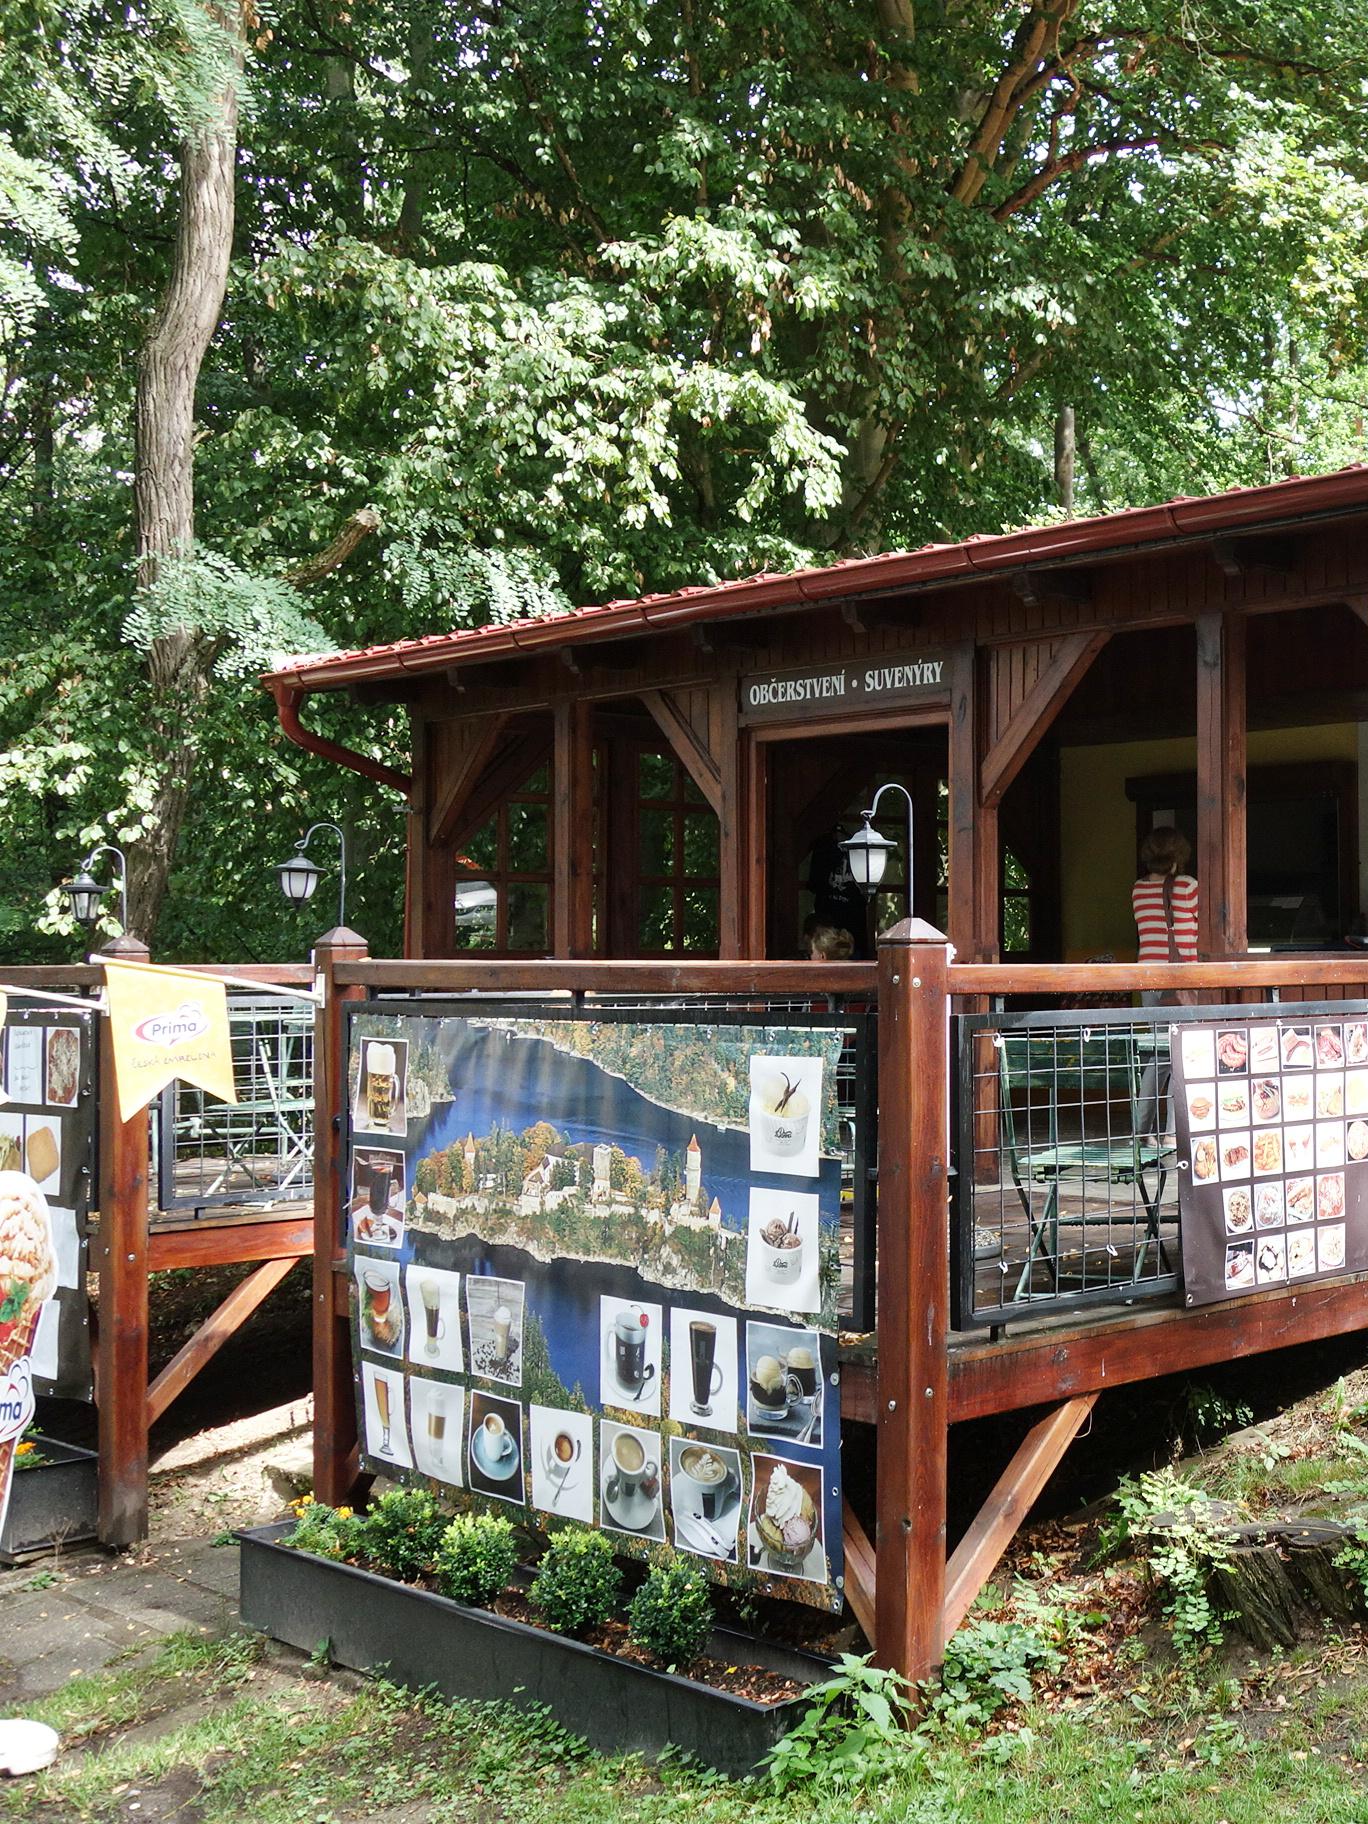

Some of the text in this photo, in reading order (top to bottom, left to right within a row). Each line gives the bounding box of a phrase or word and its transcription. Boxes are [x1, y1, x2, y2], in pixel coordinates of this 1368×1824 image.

[749, 659, 944, 706] OBČERSTVENÍ SUVENÝRY
[152, 1021, 198, 1037] Prima
